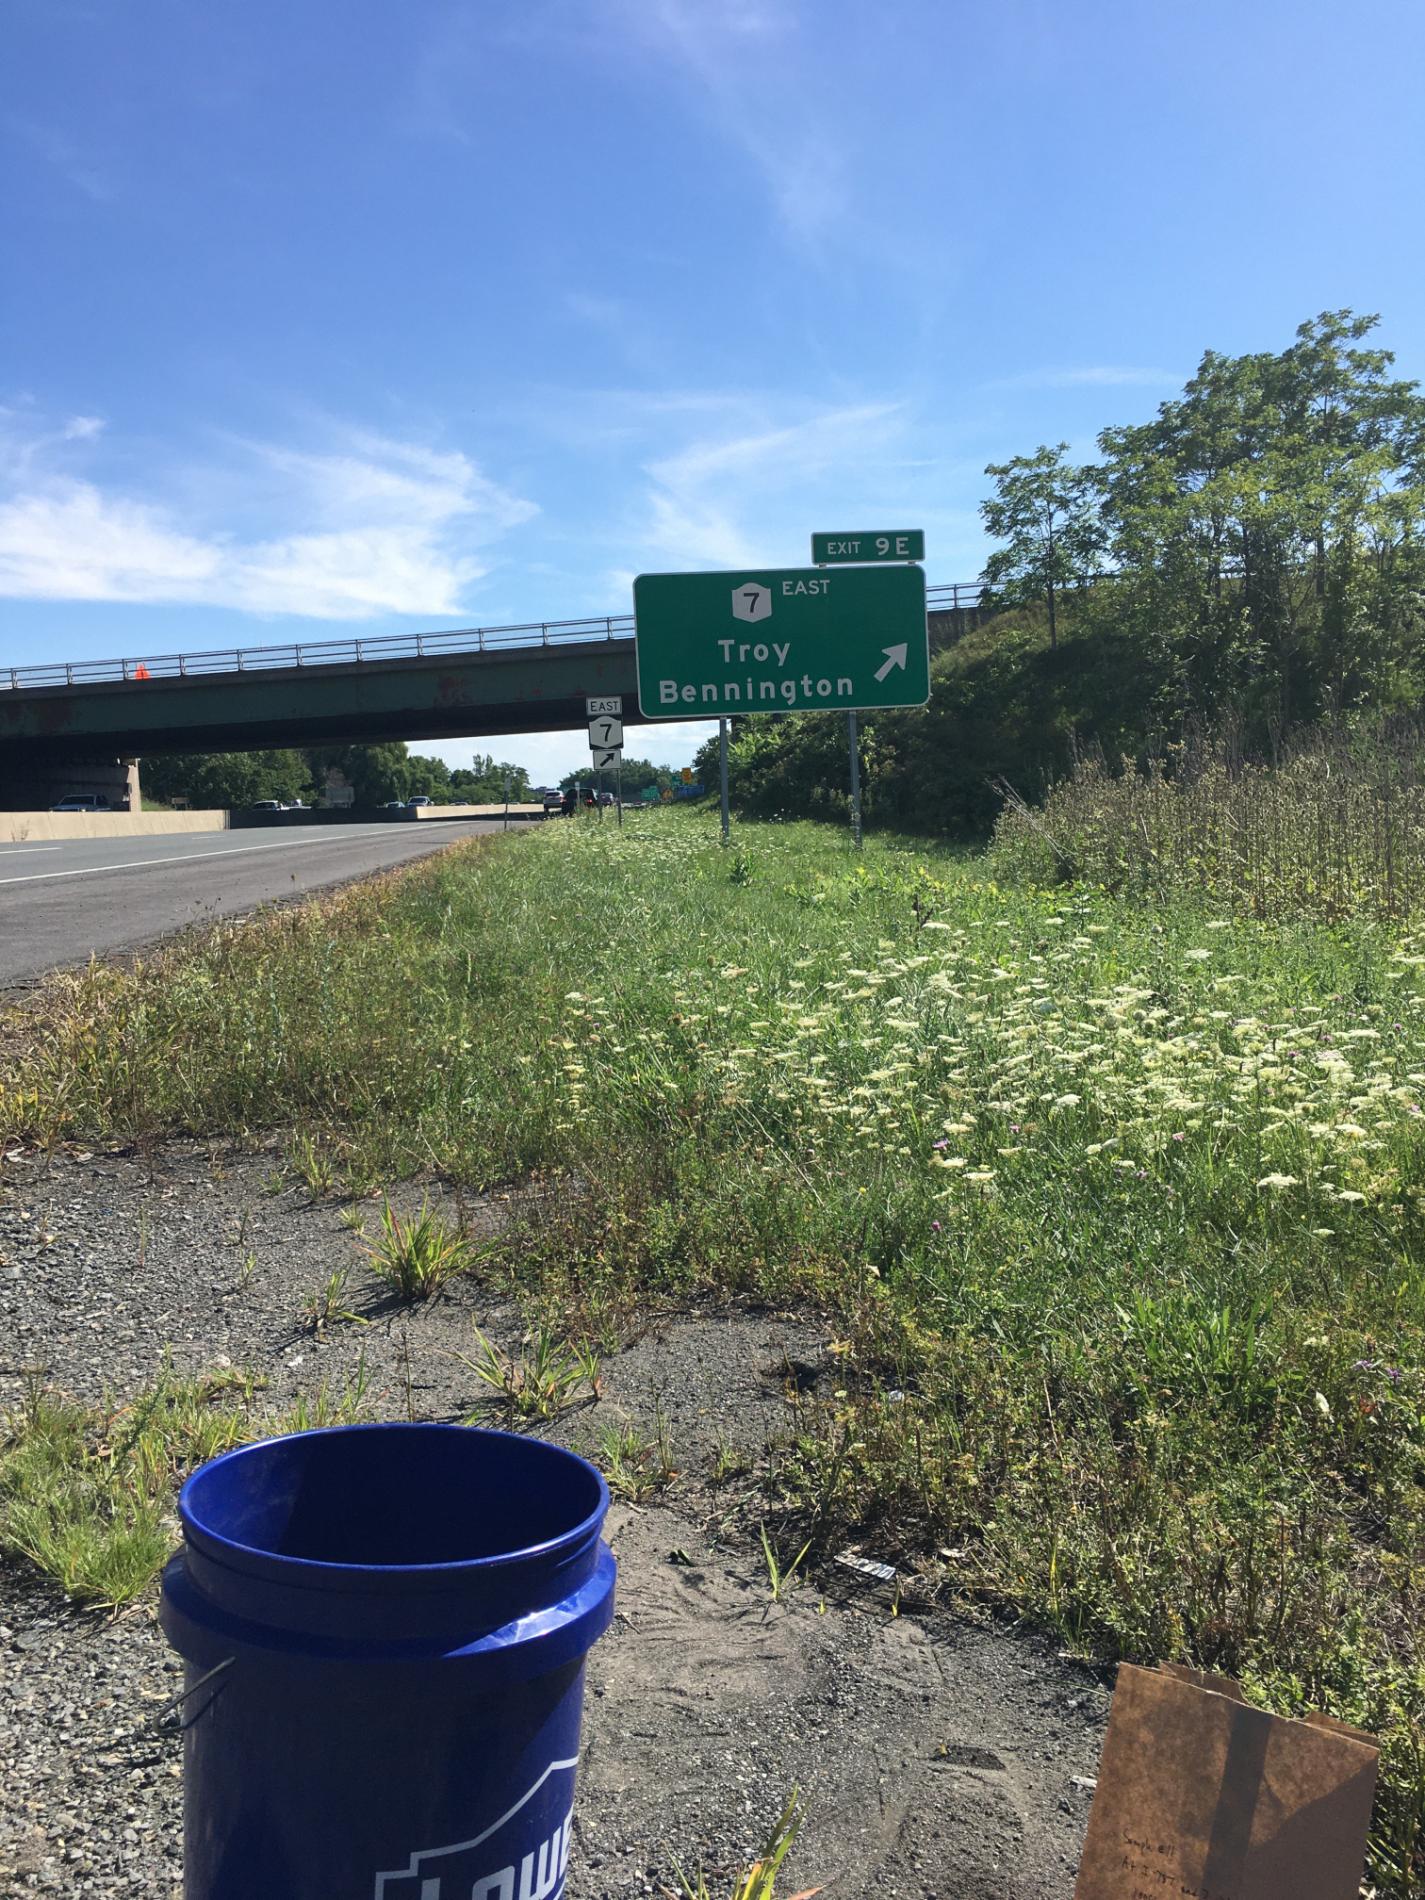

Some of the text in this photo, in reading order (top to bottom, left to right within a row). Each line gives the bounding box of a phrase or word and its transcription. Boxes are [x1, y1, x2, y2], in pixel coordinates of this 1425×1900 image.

[827, 537, 910, 556] EXIT 9E
[743, 579, 831, 613] 7 EAST
[717, 639, 791, 667] Troy
[659, 674, 853, 706] Bennington
[590, 701, 619, 712] EAST
[600, 723, 612, 742] 7
